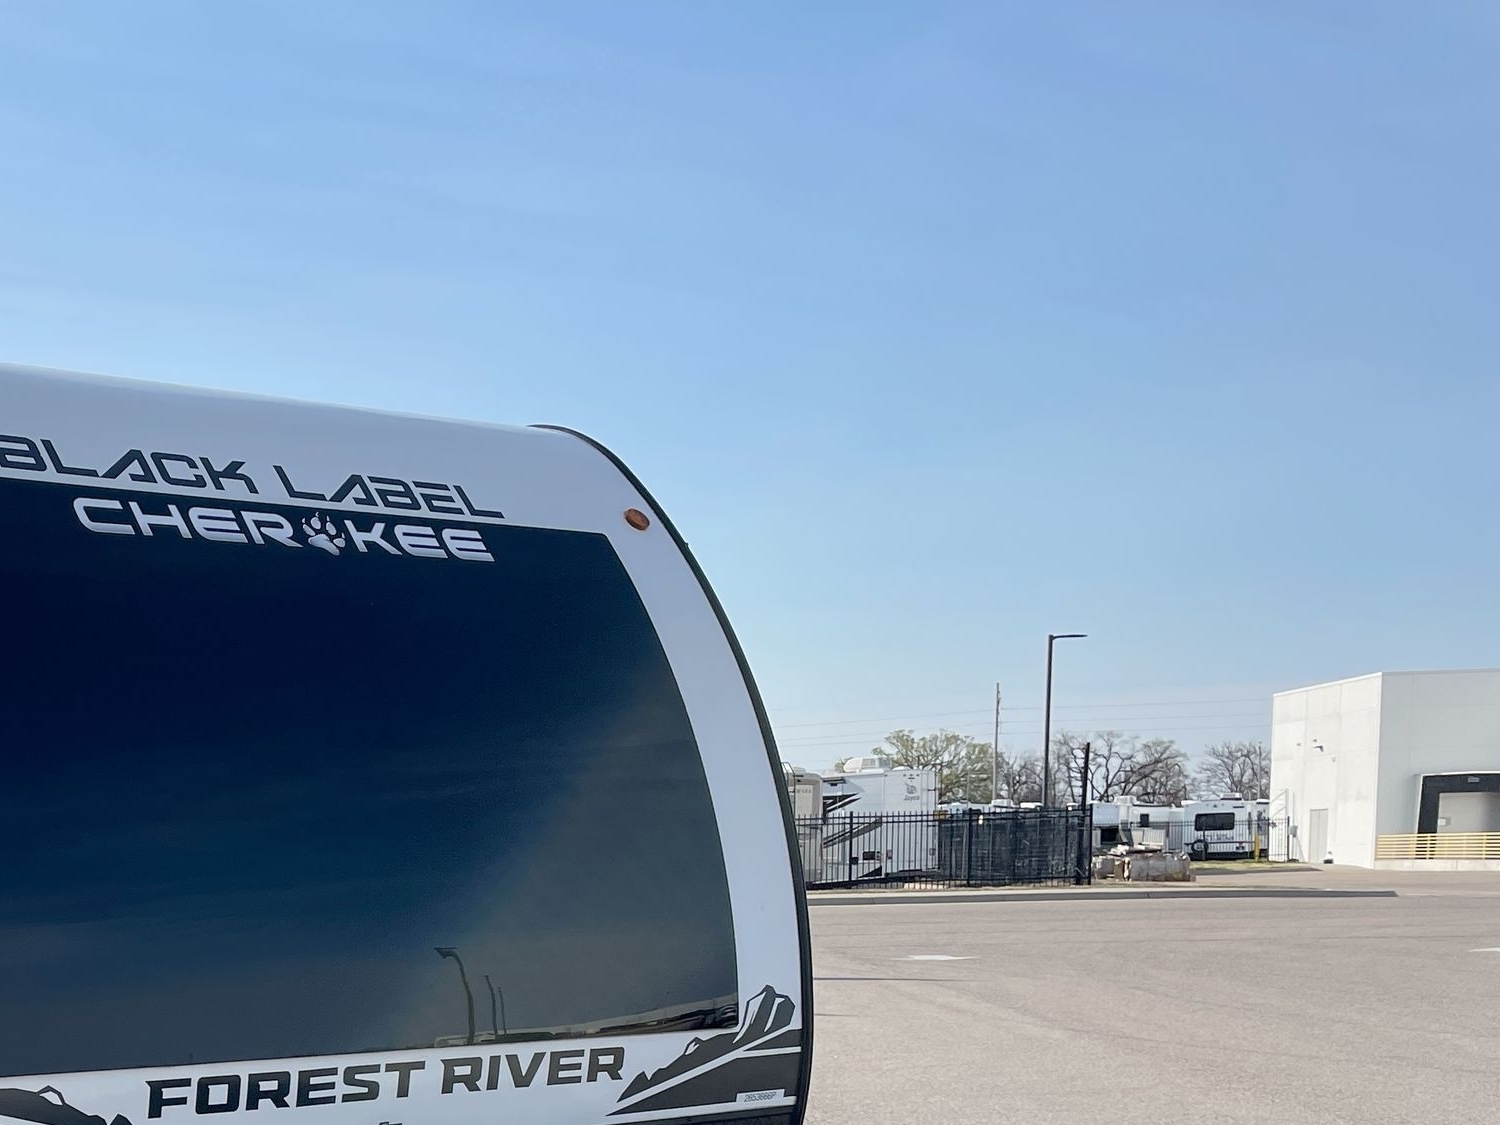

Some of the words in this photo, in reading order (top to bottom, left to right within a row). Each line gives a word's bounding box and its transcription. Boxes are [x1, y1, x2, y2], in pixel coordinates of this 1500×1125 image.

[272, 464, 505, 519] LABEL
[145, 1060, 426, 1119] FOREST
[440, 1047, 625, 1094] RIVER
